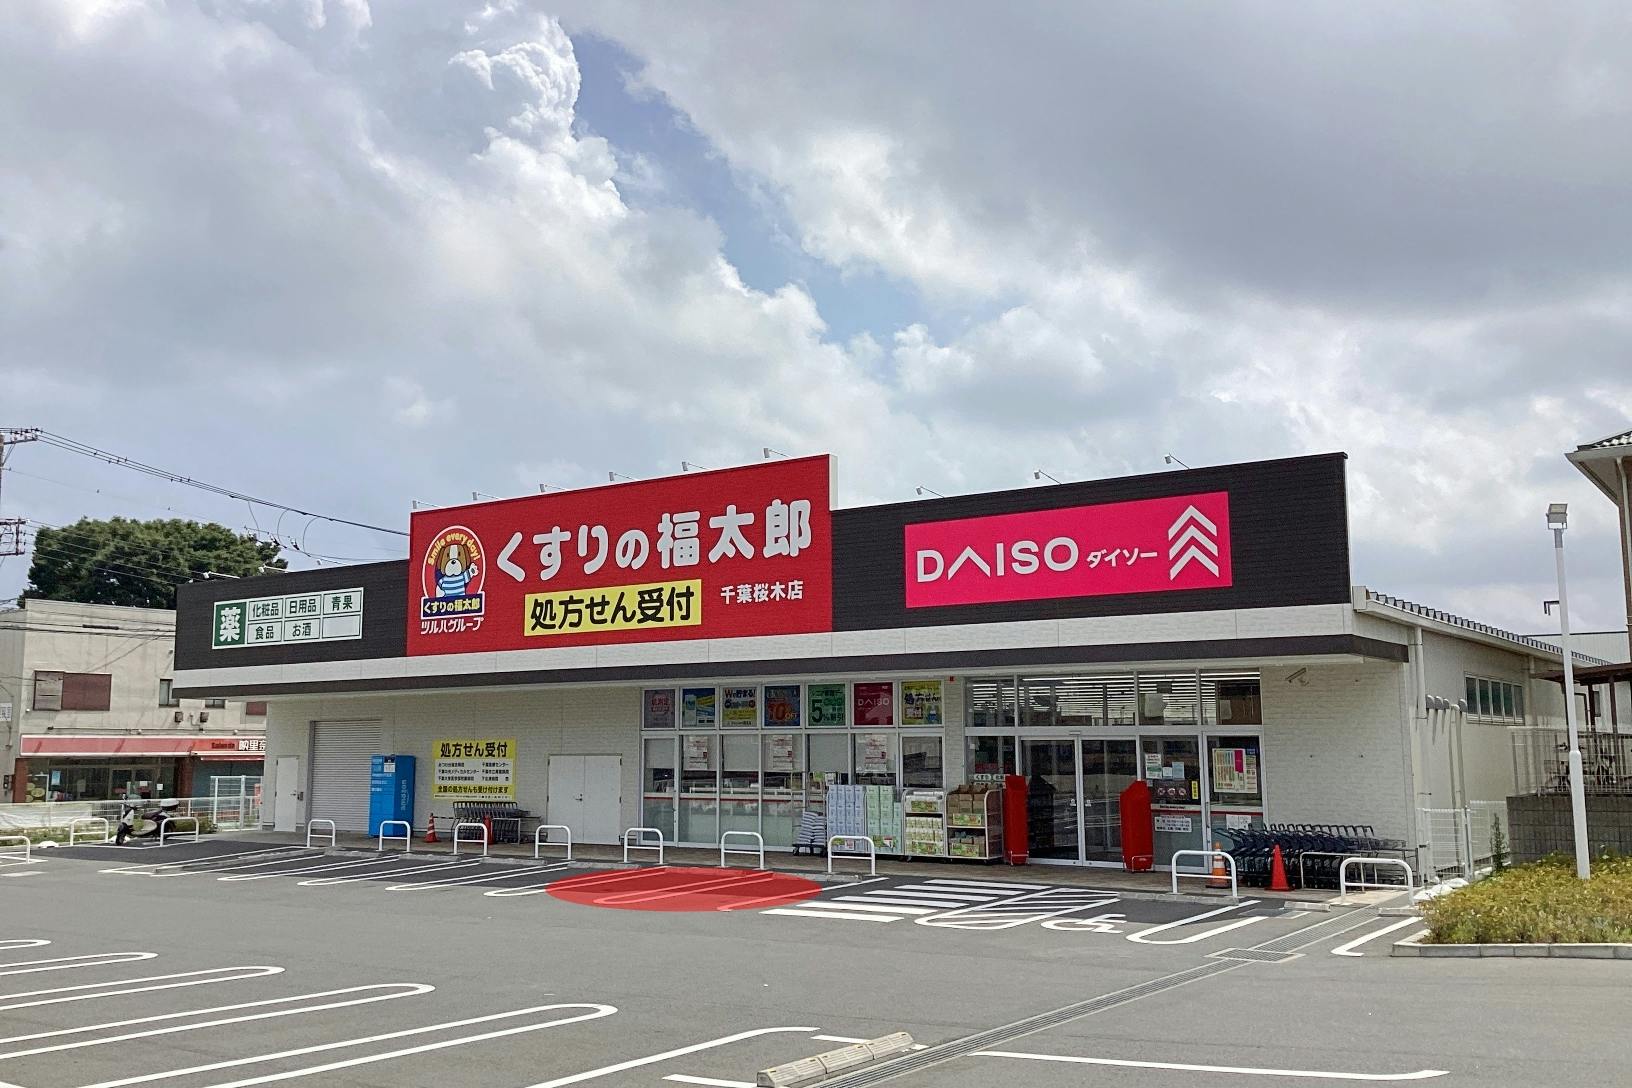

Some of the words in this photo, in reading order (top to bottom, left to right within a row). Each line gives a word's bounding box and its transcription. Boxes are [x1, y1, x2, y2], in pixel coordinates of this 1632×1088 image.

[446, 532, 468, 545] every
[497, 499, 812, 582] くすりの福太郎
[916, 536, 1079, 583] DAISO
[1087, 548, 1158, 569] ダイソー
[720, 580, 803, 605] 千葉桜木店
[252, 602, 279, 618] 化粧品
[289, 599, 317, 614] 日用品
[331, 595, 353, 611] 青果
[424, 598, 481, 614] くすりの福太郎
[530, 585, 695, 631] 処方せん受付
[219, 606, 241, 642] 薬
[292, 622, 312, 637] お酒
[421, 617, 484, 635] ツルハグループ
[255, 625, 274, 640] 食品
[857, 698, 890, 706] DAISO
[440, 742, 508, 758] 処方せん受付
